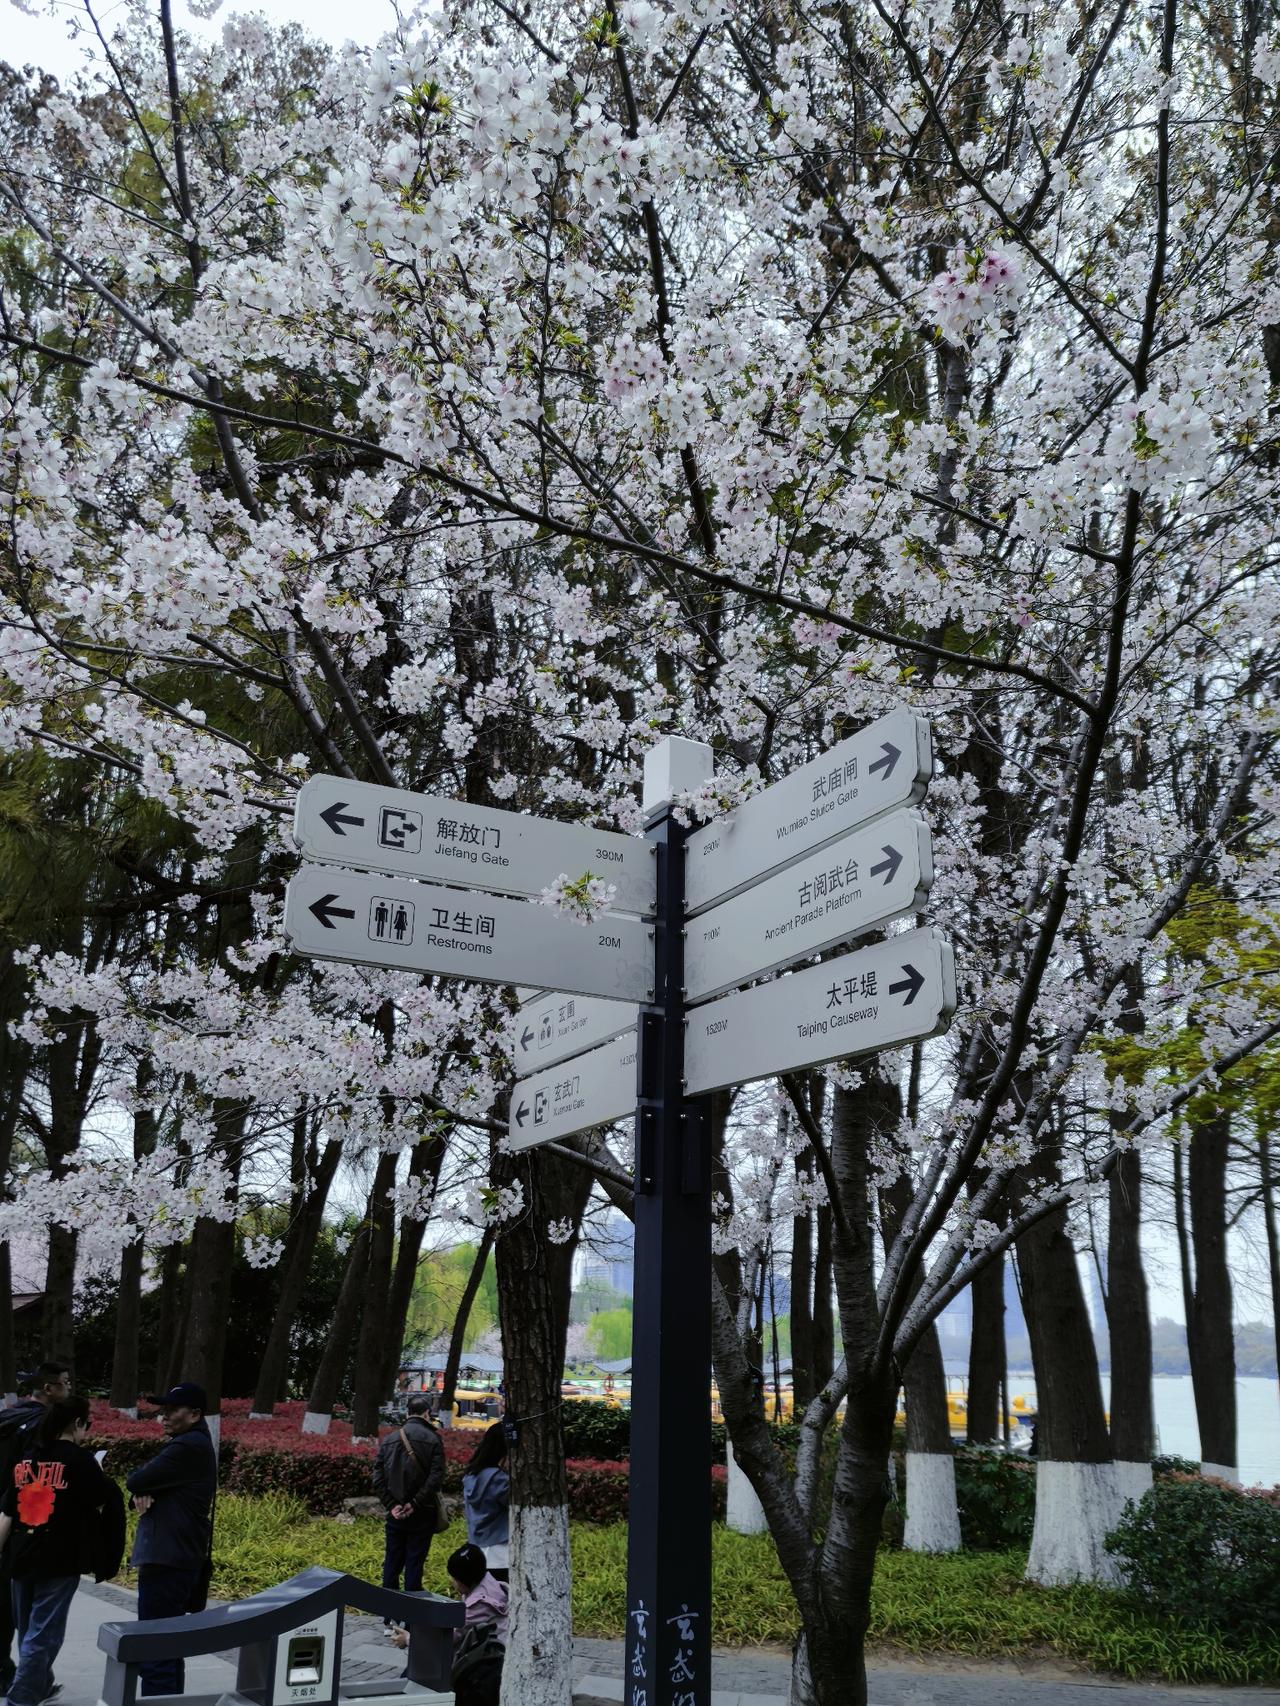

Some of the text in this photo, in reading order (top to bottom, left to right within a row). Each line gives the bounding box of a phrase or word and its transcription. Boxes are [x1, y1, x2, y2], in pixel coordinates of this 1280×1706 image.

[812, 757, 858, 802] 武庙闸
[776, 787, 859, 840] Wumiao Sluice Gate
[436, 817, 501, 849] 解放门
[435, 843, 510, 867] Jiefang Gate
[595, 848, 625, 864] 390M
[798, 858, 859, 908] 古阅武台
[429, 908, 496, 938] 卫生间
[765, 889, 862, 940] Ancient Parade Platform
[427, 934, 493, 955] Restrooms
[598, 935, 622, 949] 20M
[826, 971, 878, 1010] 太平堤
[797, 1005, 879, 1039] Taiping Causeway
[554, 1075, 579, 1102] 玄武门
